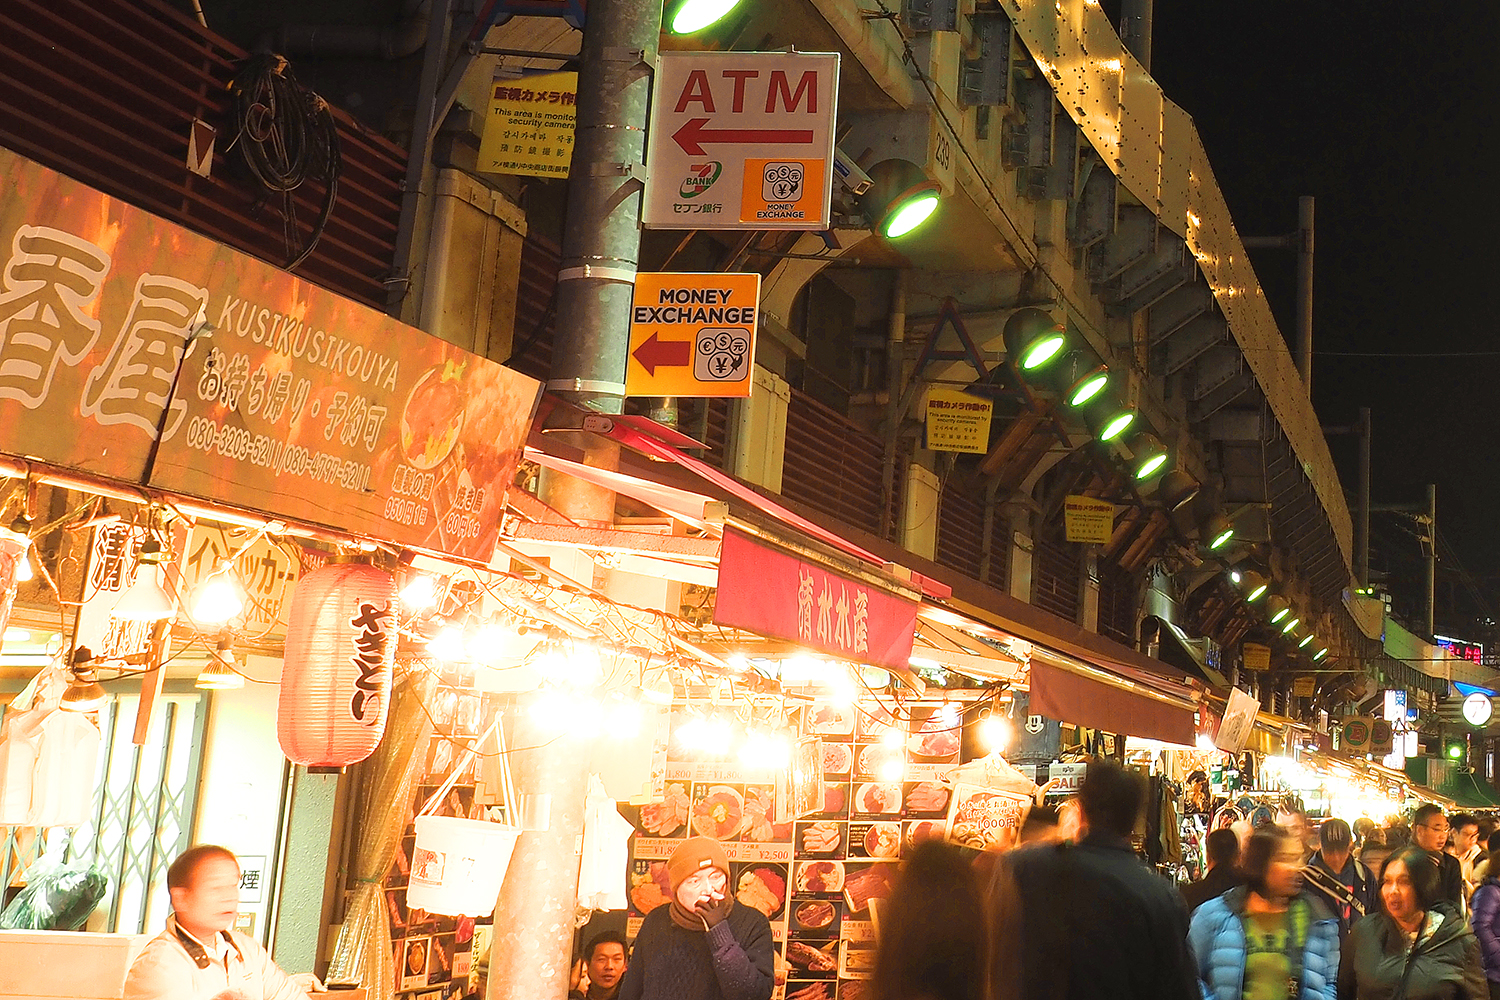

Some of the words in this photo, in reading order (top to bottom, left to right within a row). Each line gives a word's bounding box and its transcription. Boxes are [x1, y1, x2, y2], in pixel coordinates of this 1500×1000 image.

[674, 70, 818, 113] ATM
[494, 107, 512, 116] This
[508, 118, 542, 128] security
[686, 177, 713, 186] BANK
[673, 203, 722, 213] セブン銀行
[757, 211, 804, 219] EXCHANGE
[659, 288, 732, 304] MONEY
[634, 307, 755, 323] EXCHANGE
[217, 295, 400, 392] KUSIKUSIKOUYA
[976, 817, 1016, 830] 1000円
[759, 850, 789, 860] ¥2,500
